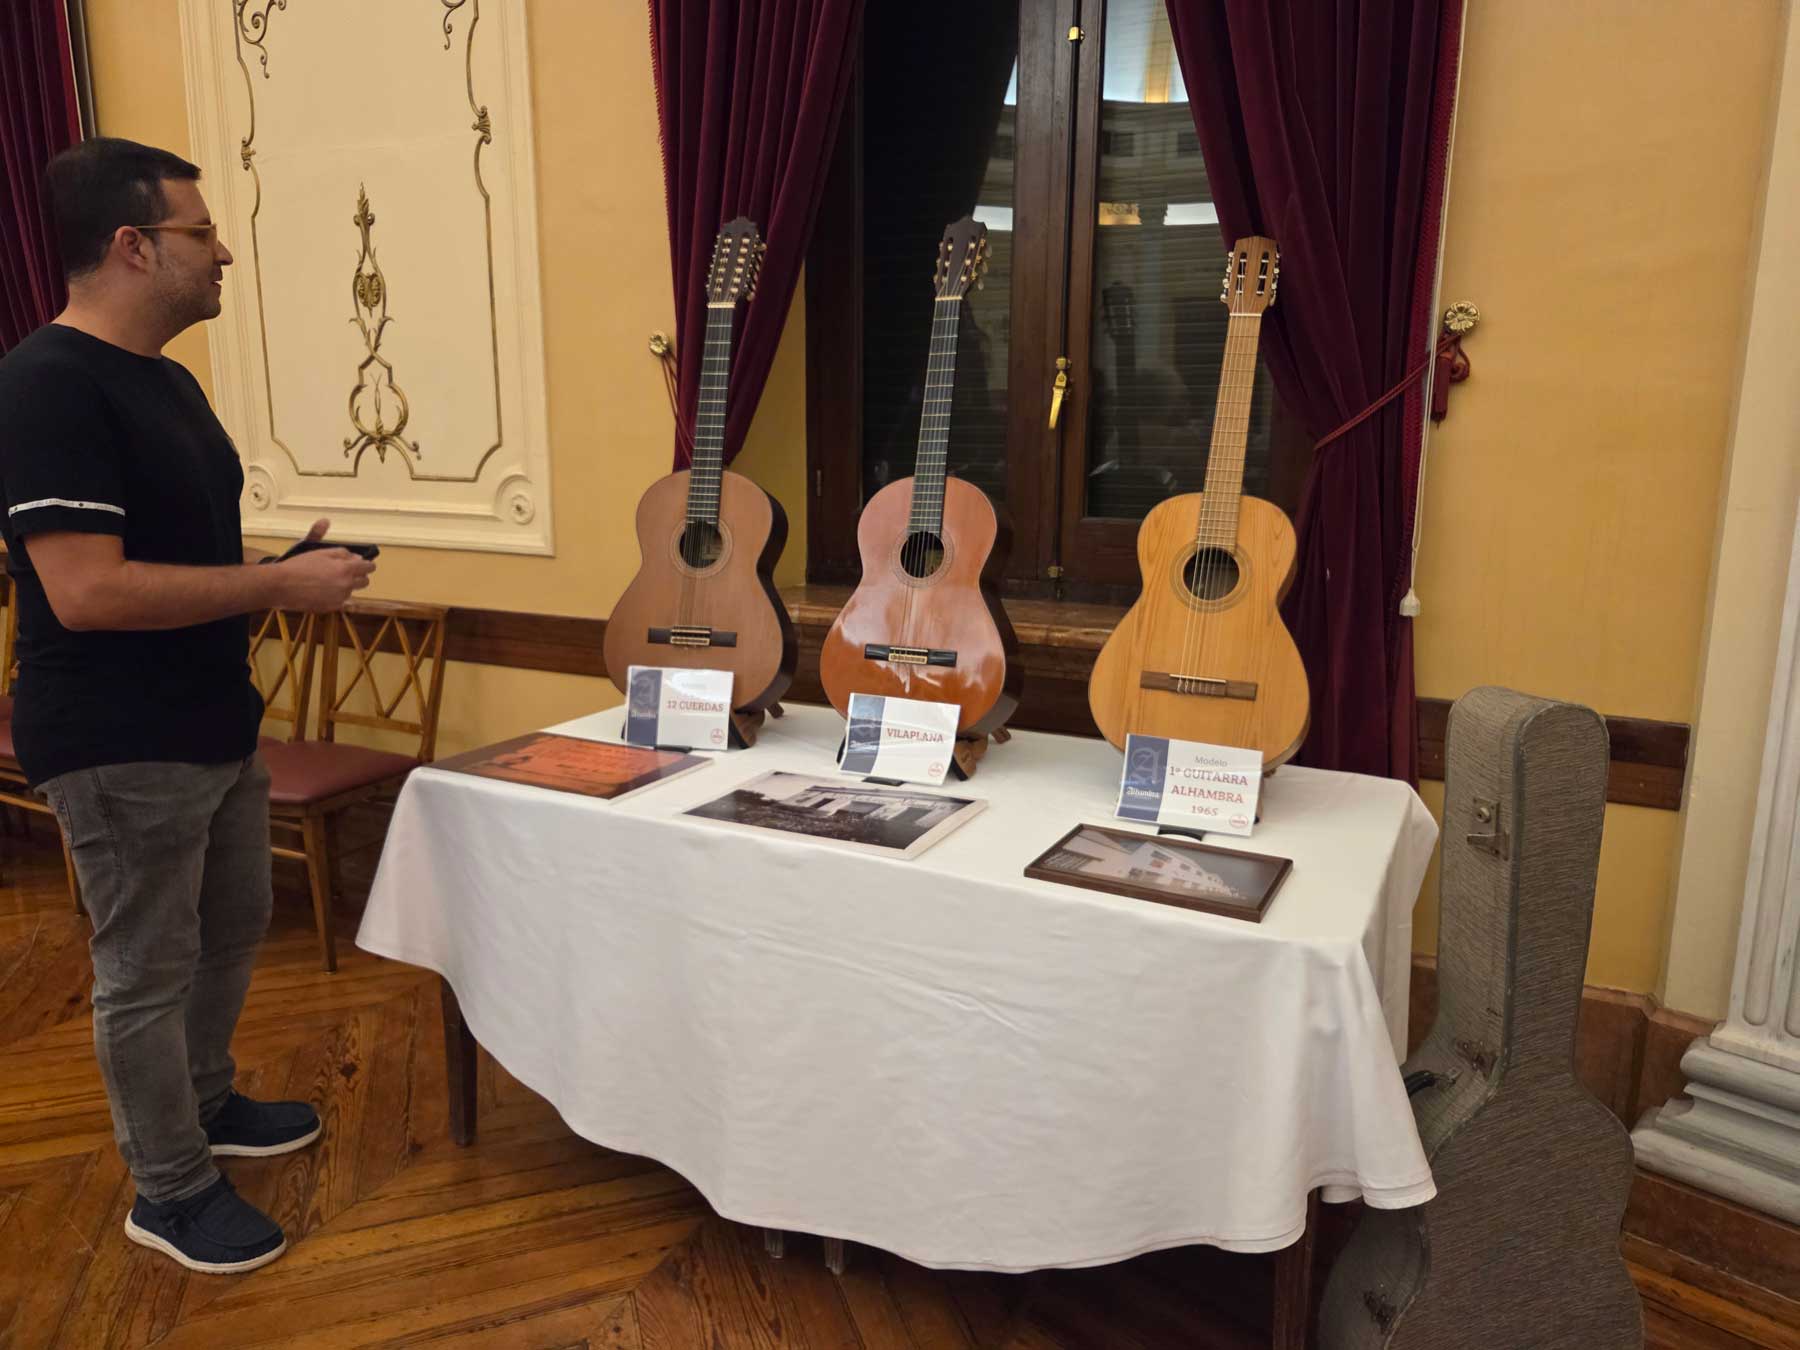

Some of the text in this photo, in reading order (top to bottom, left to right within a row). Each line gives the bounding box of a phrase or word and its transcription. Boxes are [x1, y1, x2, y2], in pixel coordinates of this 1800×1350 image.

[667, 700, 723, 712] 12 CUERDAS
[886, 727, 944, 742] VILAPLANA
[1194, 755, 1228, 767] Modelo
[1183, 768, 1248, 786] GUITARRA
[1171, 784, 1243, 804] ALHAMBRA
[1191, 805, 1219, 817] 1965
